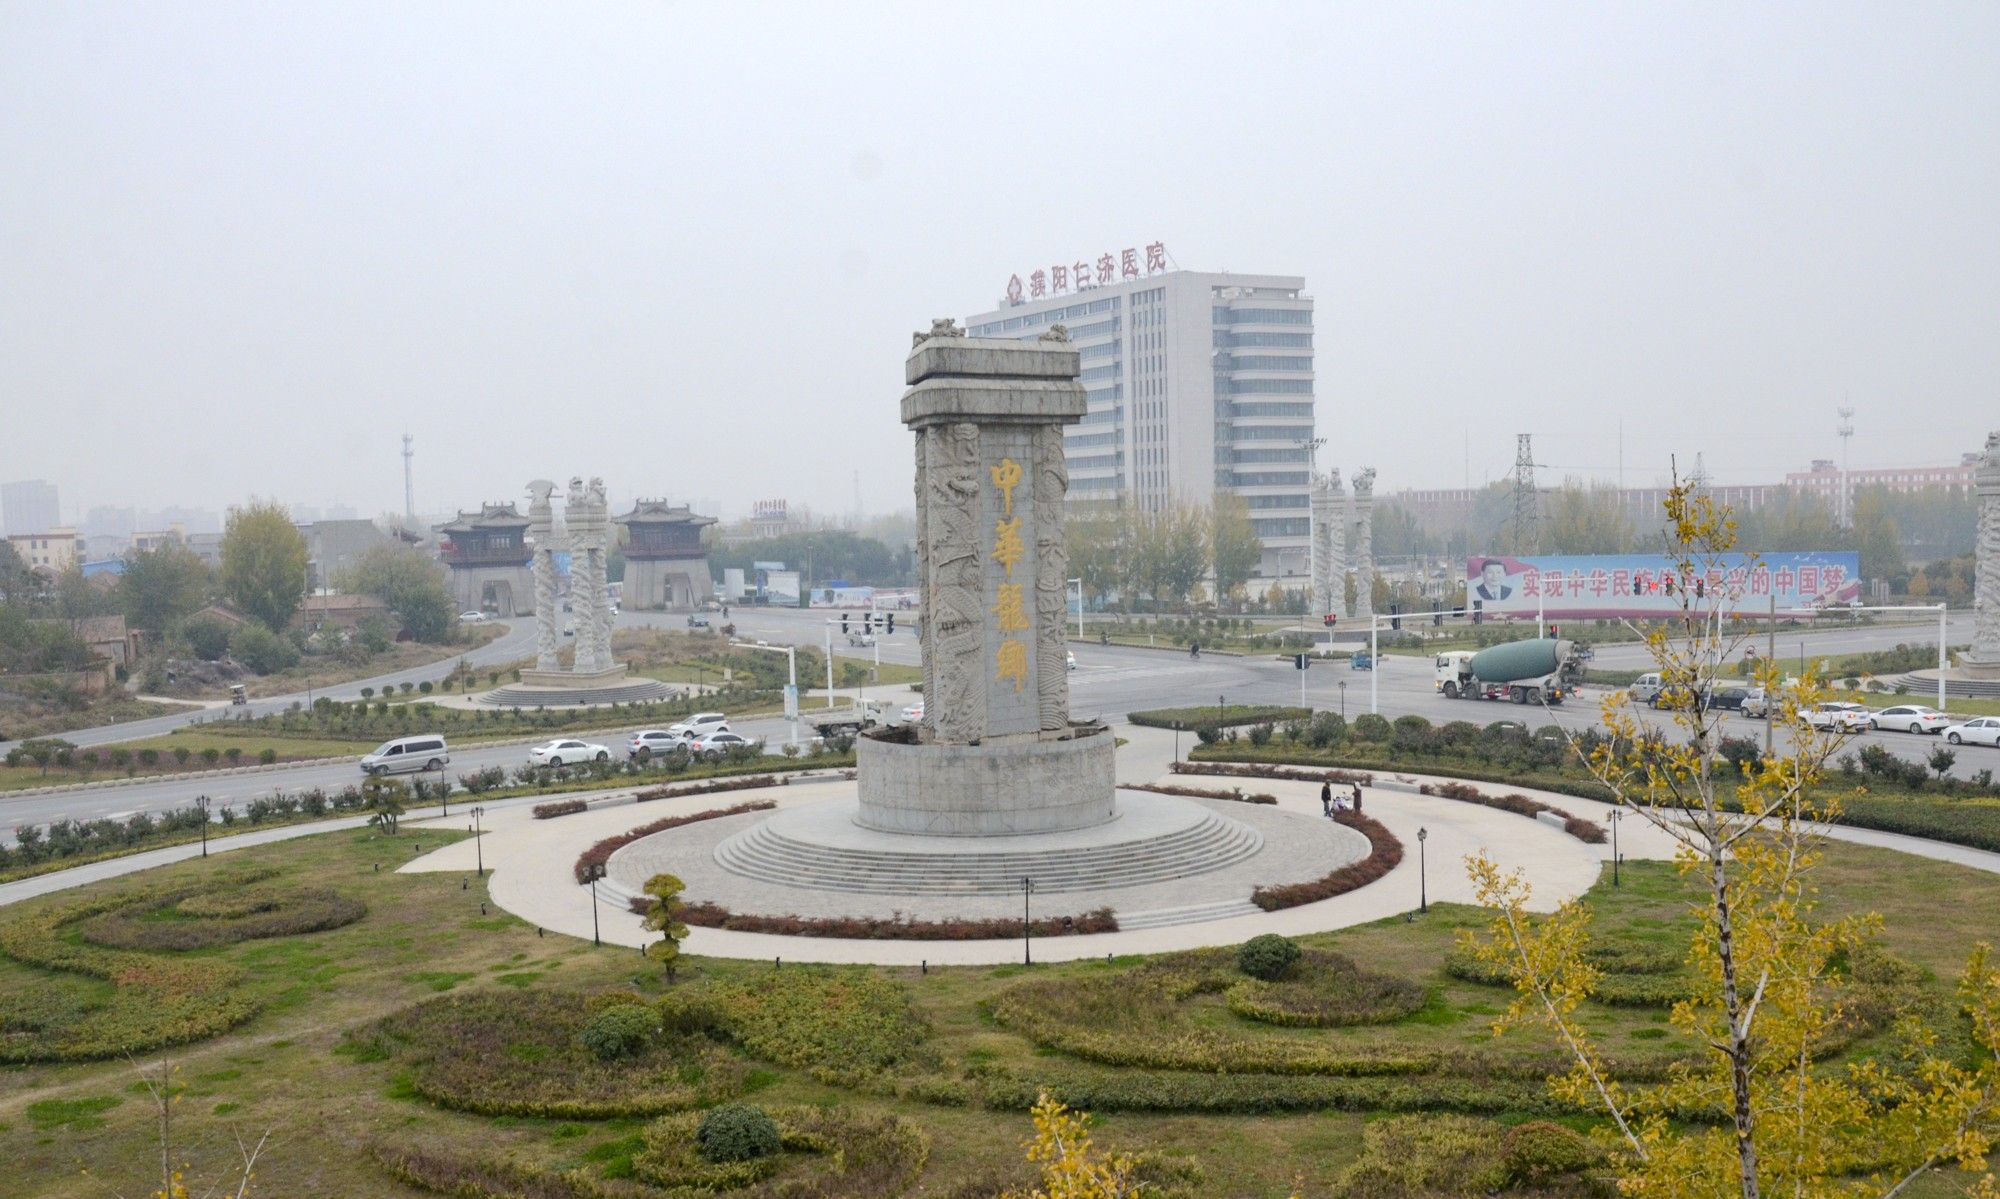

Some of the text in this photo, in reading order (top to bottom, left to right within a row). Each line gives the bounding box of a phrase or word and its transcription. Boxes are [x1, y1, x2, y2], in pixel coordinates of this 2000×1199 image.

[1030, 241, 1166, 297] 濮阳仁济医院
